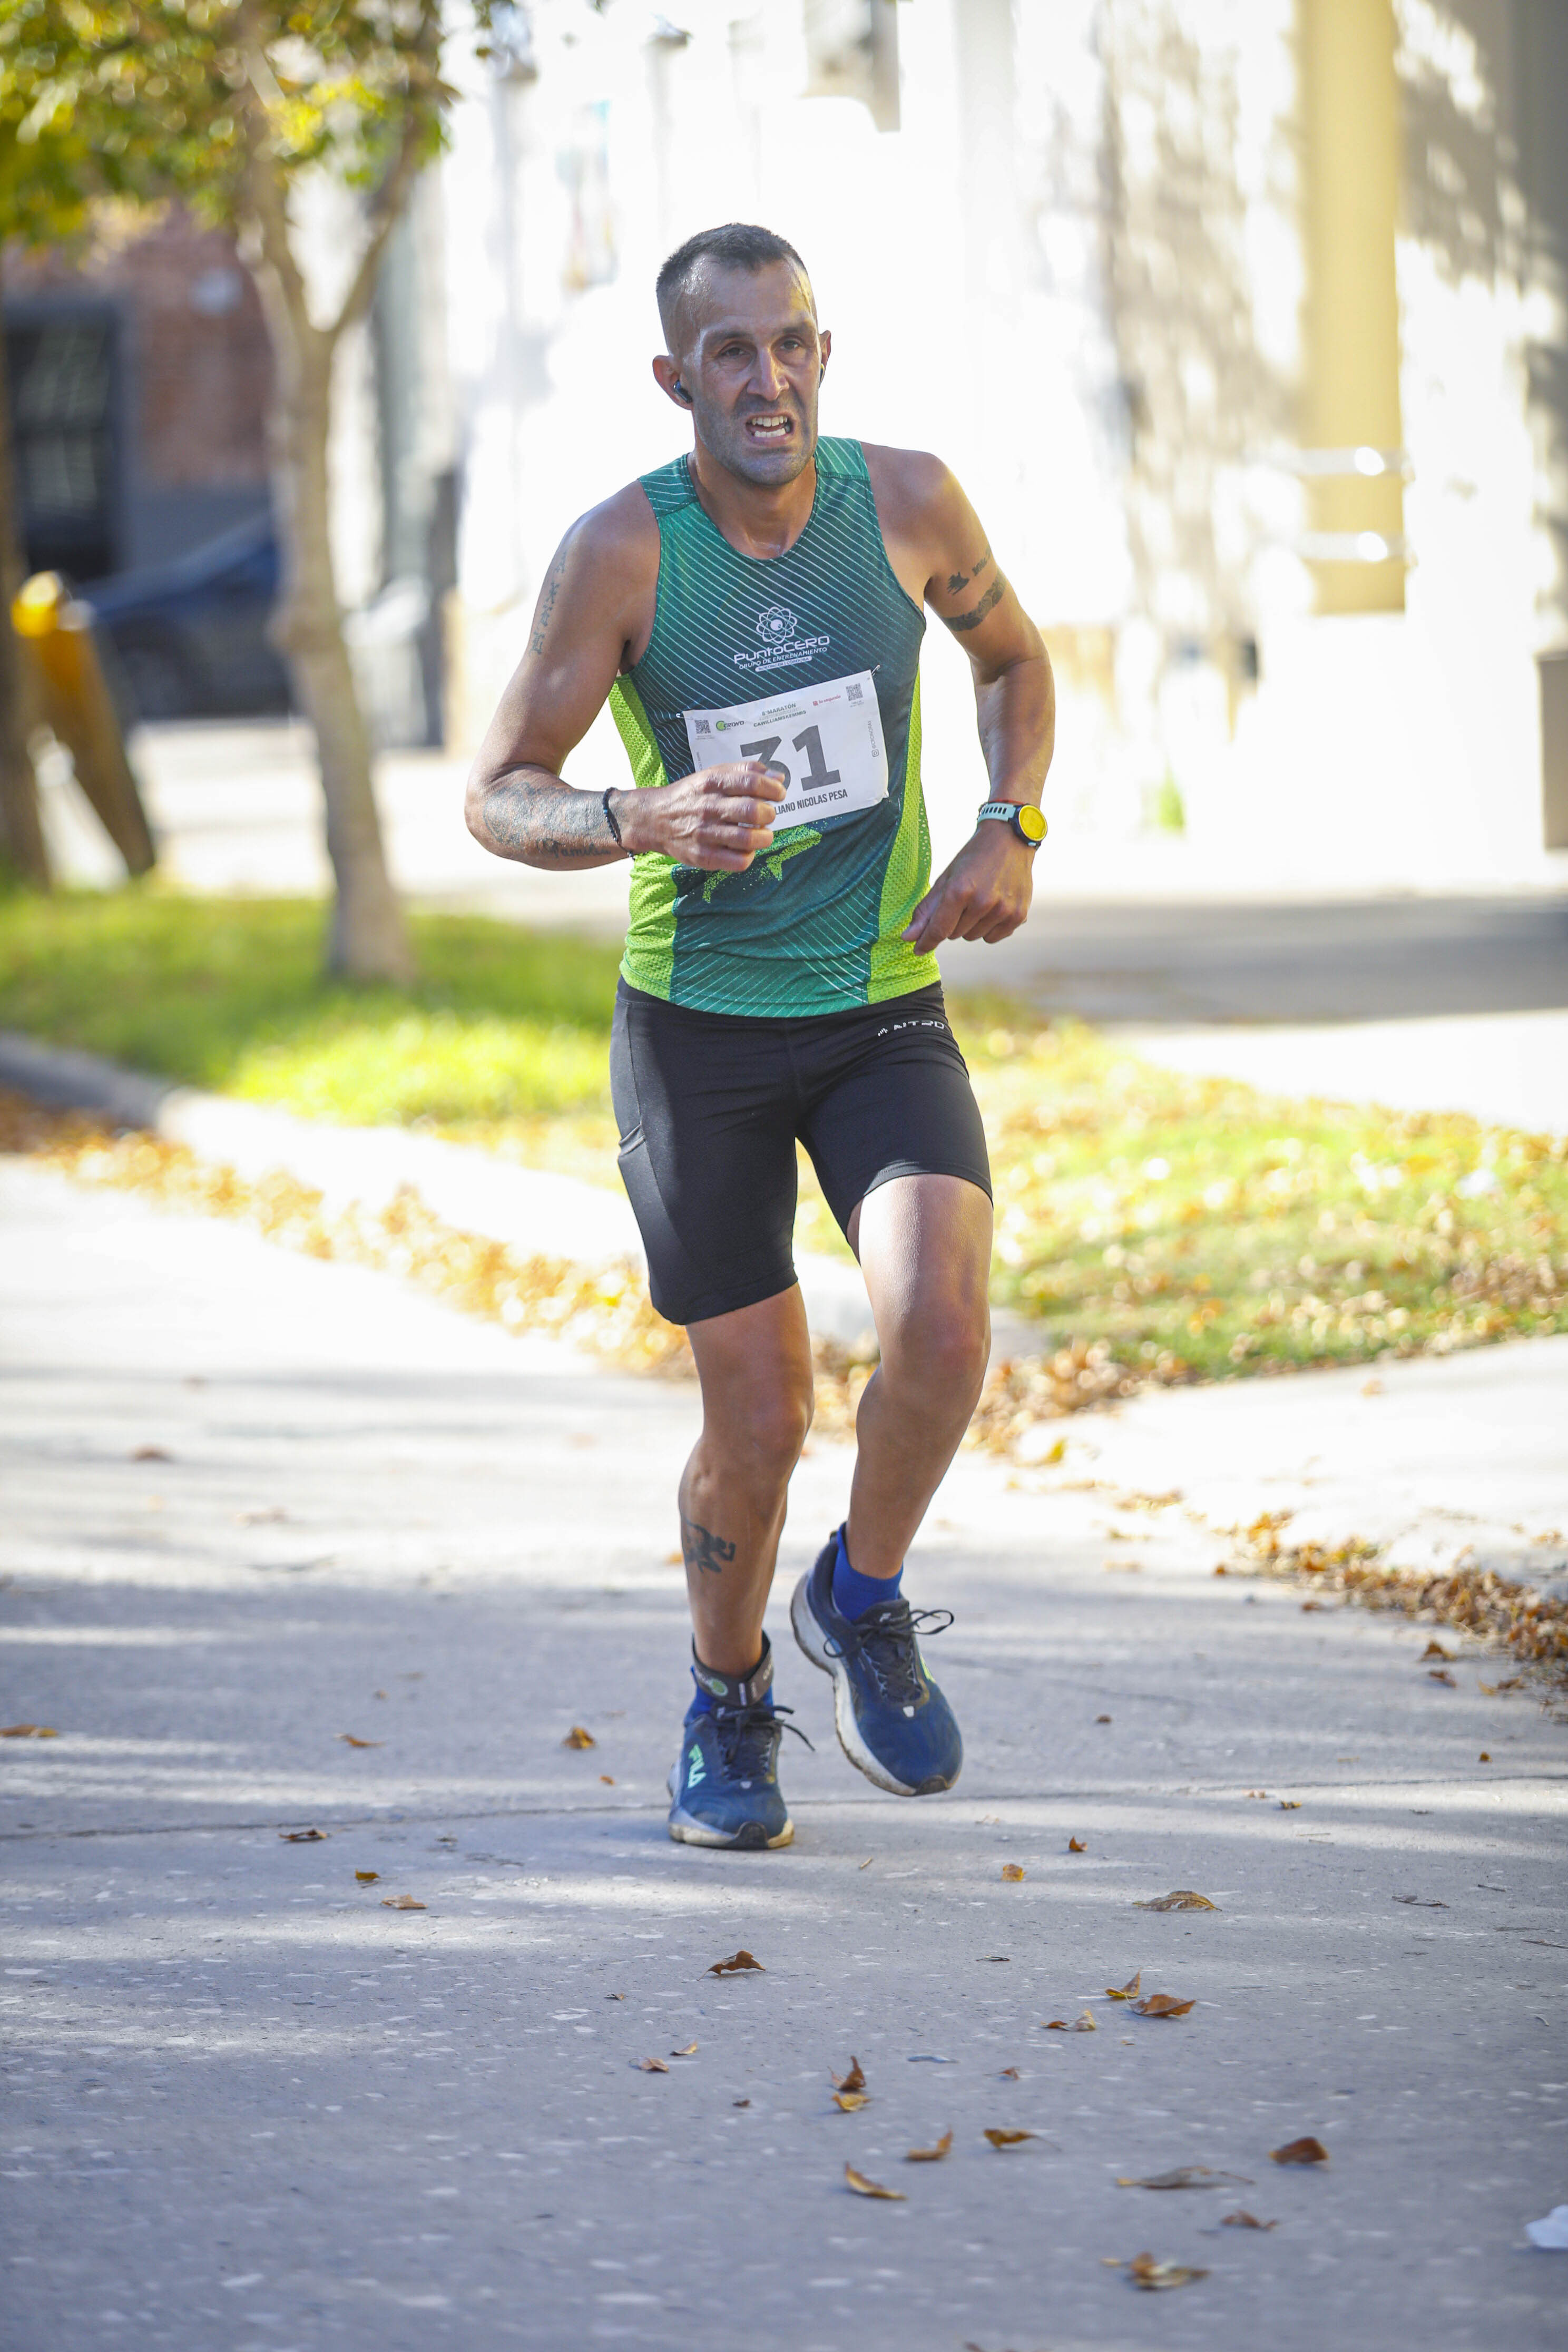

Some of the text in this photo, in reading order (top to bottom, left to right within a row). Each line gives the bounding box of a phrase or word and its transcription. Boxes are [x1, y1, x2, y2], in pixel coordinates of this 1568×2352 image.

[773, 647, 827, 662] ENTRENAMIENTO
[740, 725, 841, 791] 31
[775, 789, 848, 815] LIANO NICOLAS PESA
